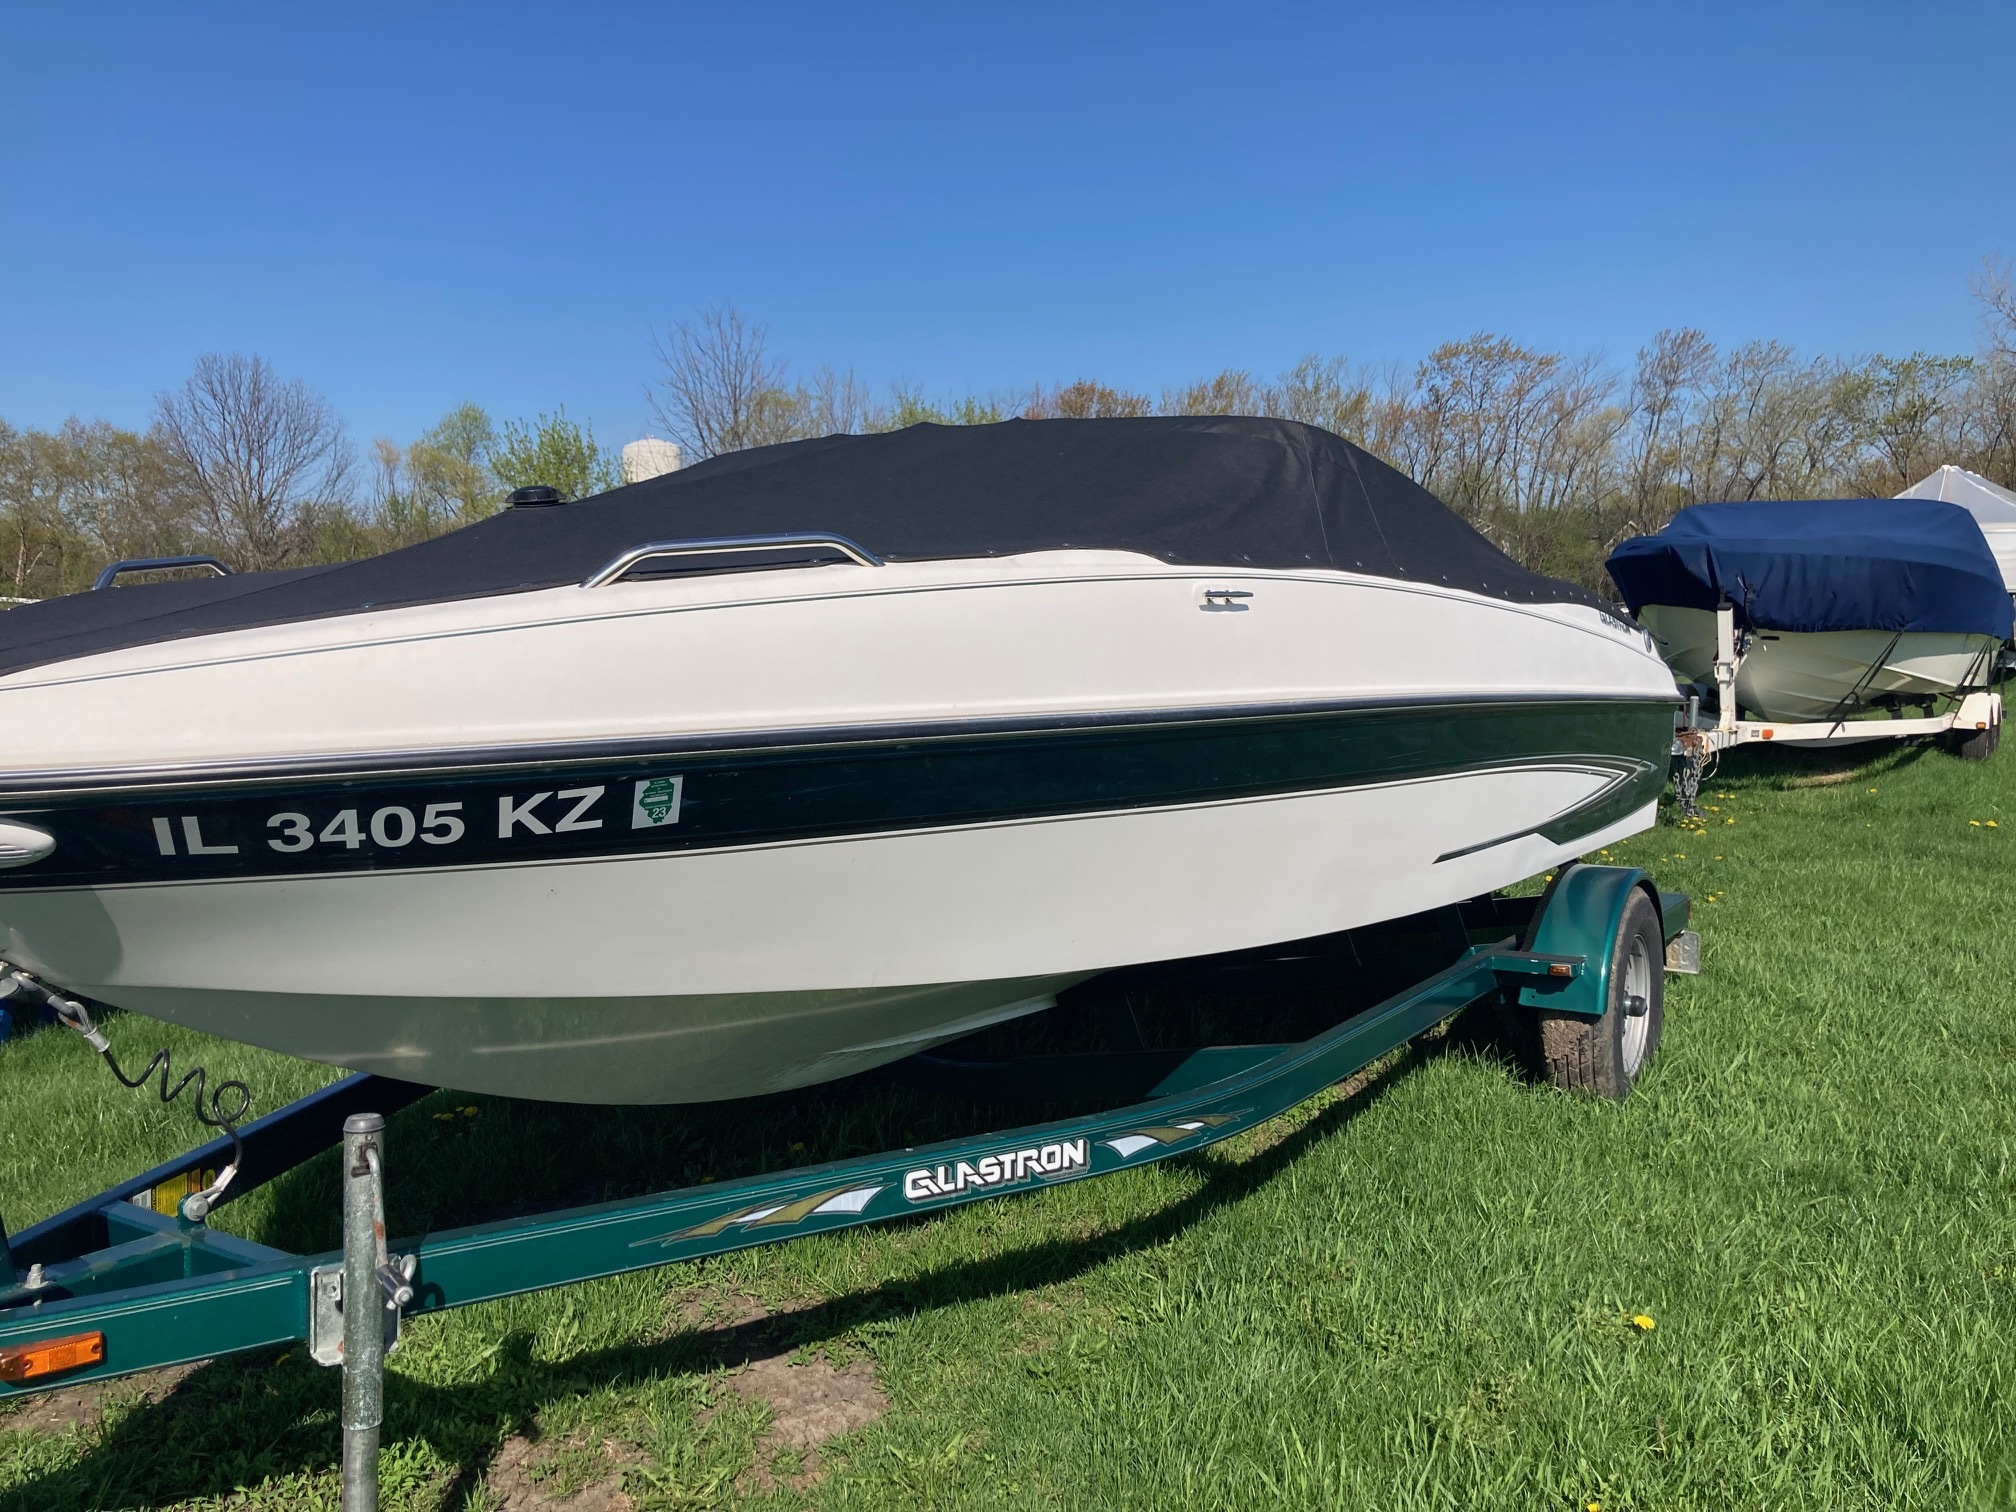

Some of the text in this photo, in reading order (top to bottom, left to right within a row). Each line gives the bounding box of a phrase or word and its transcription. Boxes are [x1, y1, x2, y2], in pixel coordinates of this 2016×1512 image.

[152, 785, 606, 856] IL 3405 KZ
[651, 806, 667, 819] 23
[904, 1138, 1088, 1201] GLASTRON
